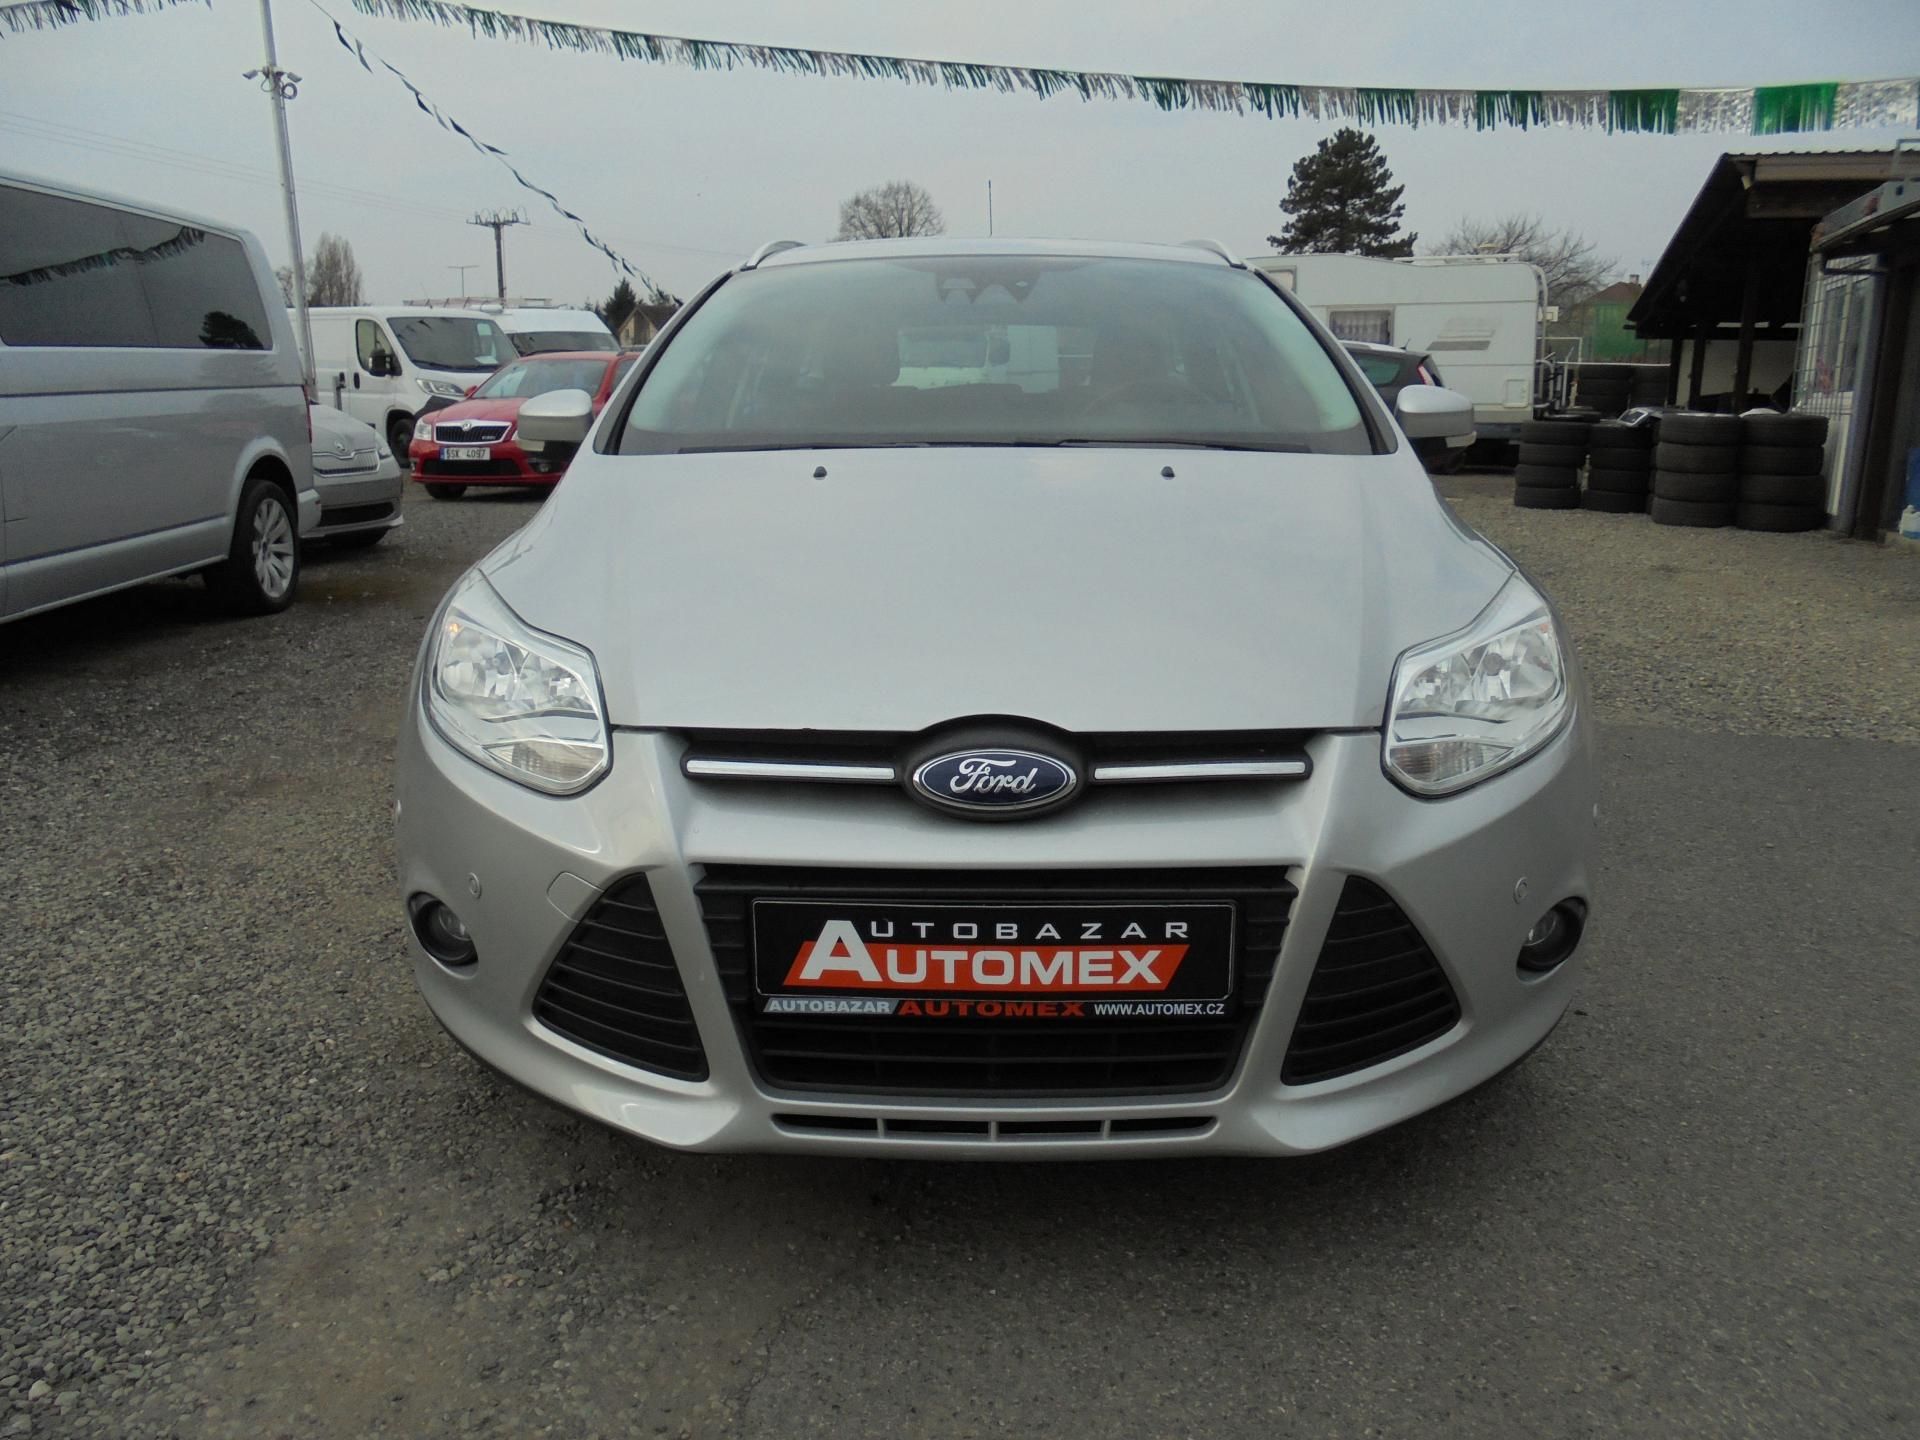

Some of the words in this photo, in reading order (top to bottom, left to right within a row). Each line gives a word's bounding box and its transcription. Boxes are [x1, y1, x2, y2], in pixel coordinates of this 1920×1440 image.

[949, 758, 1039, 794] Ford
[799, 919, 1162, 985] AUTOMEX
[769, 1000, 890, 1013] AUTOBAZAR
[899, 1000, 1085, 1017] AUTOMEX
[1094, 1003, 1225, 1016] WWW.AUTOMEX.CZ
